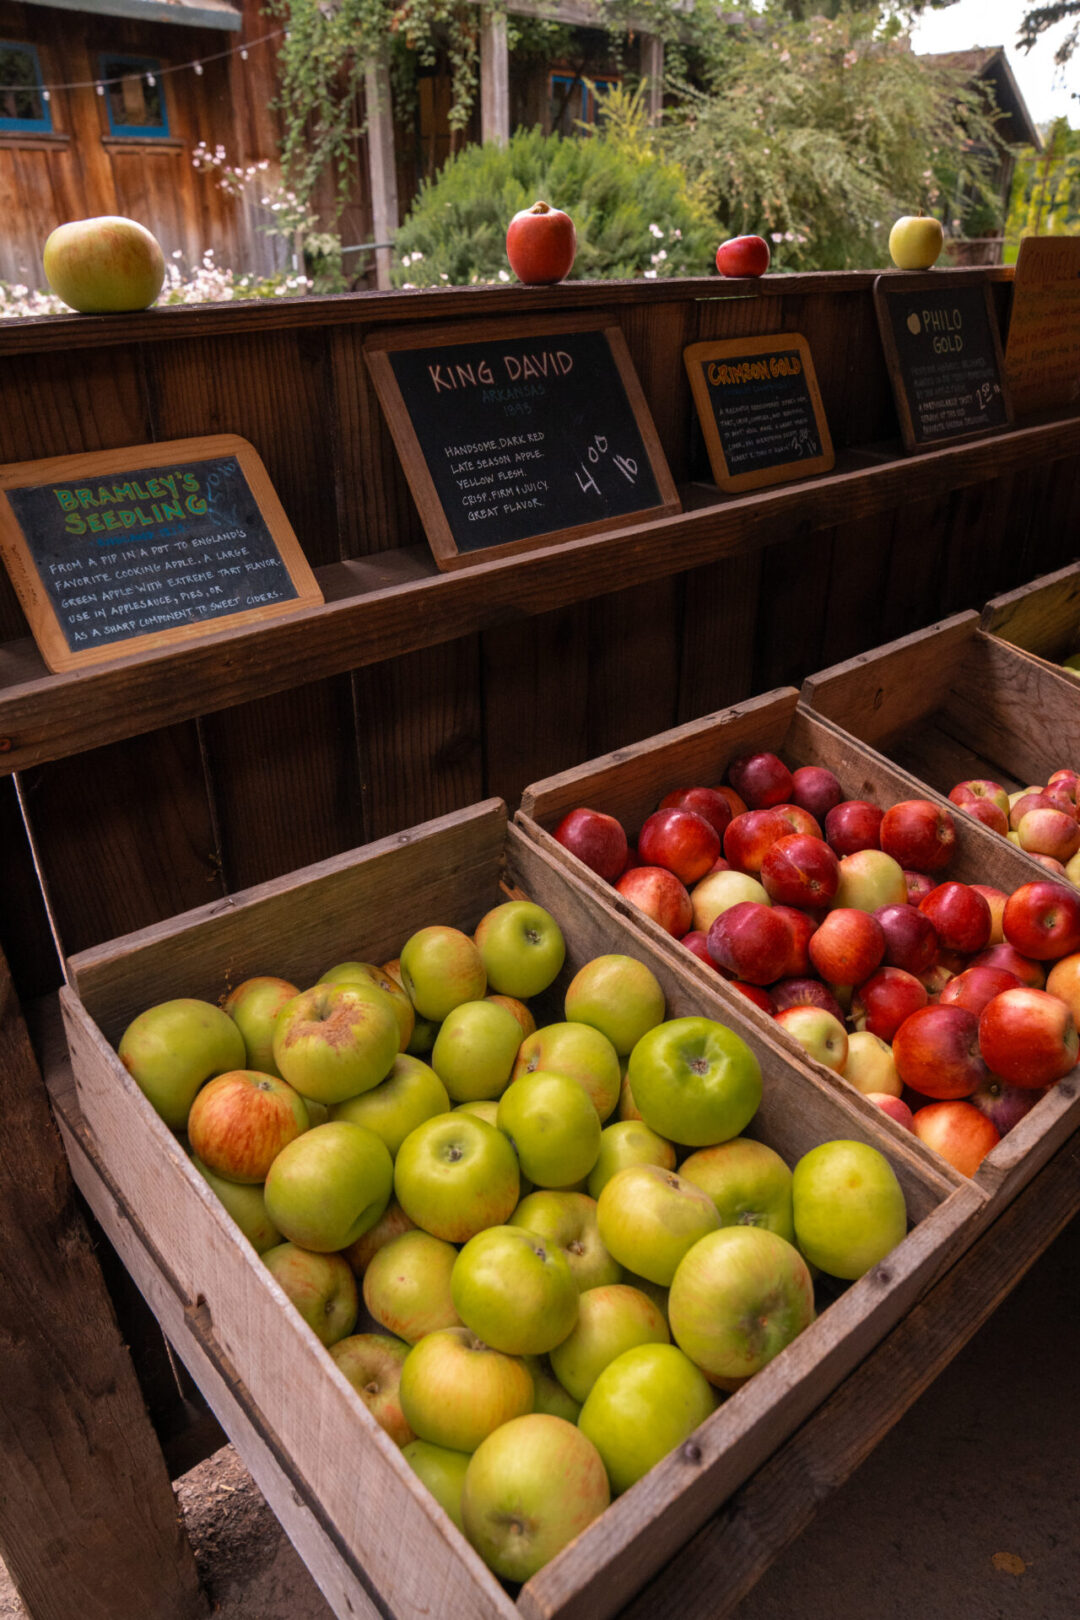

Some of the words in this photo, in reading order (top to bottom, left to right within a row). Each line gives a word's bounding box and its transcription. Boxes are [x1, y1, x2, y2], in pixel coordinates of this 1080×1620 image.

[922, 309, 963, 331] PHILO
[932, 334, 964, 354] GOLD
[428, 360, 495, 393] KING
[503, 351, 573, 381] DAVID
[707, 361, 772, 386] CRIMSON
[769, 356, 801, 378] GOLD
[499, 435, 526, 448] DARK
[527, 432, 545, 442] RED
[450, 460, 475, 475] LATE
[476, 454, 512, 470] SEASON
[456, 474, 494, 490] YELLOW
[497, 468, 527, 481] FLESH.
[53, 472, 200, 511] BRAMLEY'S
[491, 487, 515, 499] FIRM
[64, 494, 208, 535] SEEDLING
[467, 506, 499, 521] GREAT
[49, 560, 83, 575] FROM
[88, 558, 98, 567] A
[101, 553, 117, 565] PIP
[122, 550, 136, 561] IN
[140, 548, 149, 558] A
[151, 543, 170, 556] POT
[174, 541, 188, 551] TO
[191, 529, 247, 548] ENGLAND'S
[55, 573, 113, 592] FAVORITE
[115, 563, 161, 580] COOKING
[164, 556, 202, 570] APPLE.
[204, 553, 213, 563] A
[216, 547, 250, 561] LARGE
[61, 593, 98, 608] GREEN
[102, 587, 135, 602] APPLE
[135, 580, 162, 593] WITH
[167, 571, 215, 588] EXTREME
[218, 566, 241, 577] TART
[245, 558, 281, 571] FLAVOR.
[68, 611, 91, 624] USE
[94, 608, 106, 618] IN
[209, 585, 224, 595] OR
[74, 631, 88, 641] AS
[92, 628, 102, 637] A
[103, 620, 136, 635] SHARP
[139, 607, 194, 628] COMPONENT
[196, 605, 208, 614] TO
[210, 597, 241, 612] SWEET
